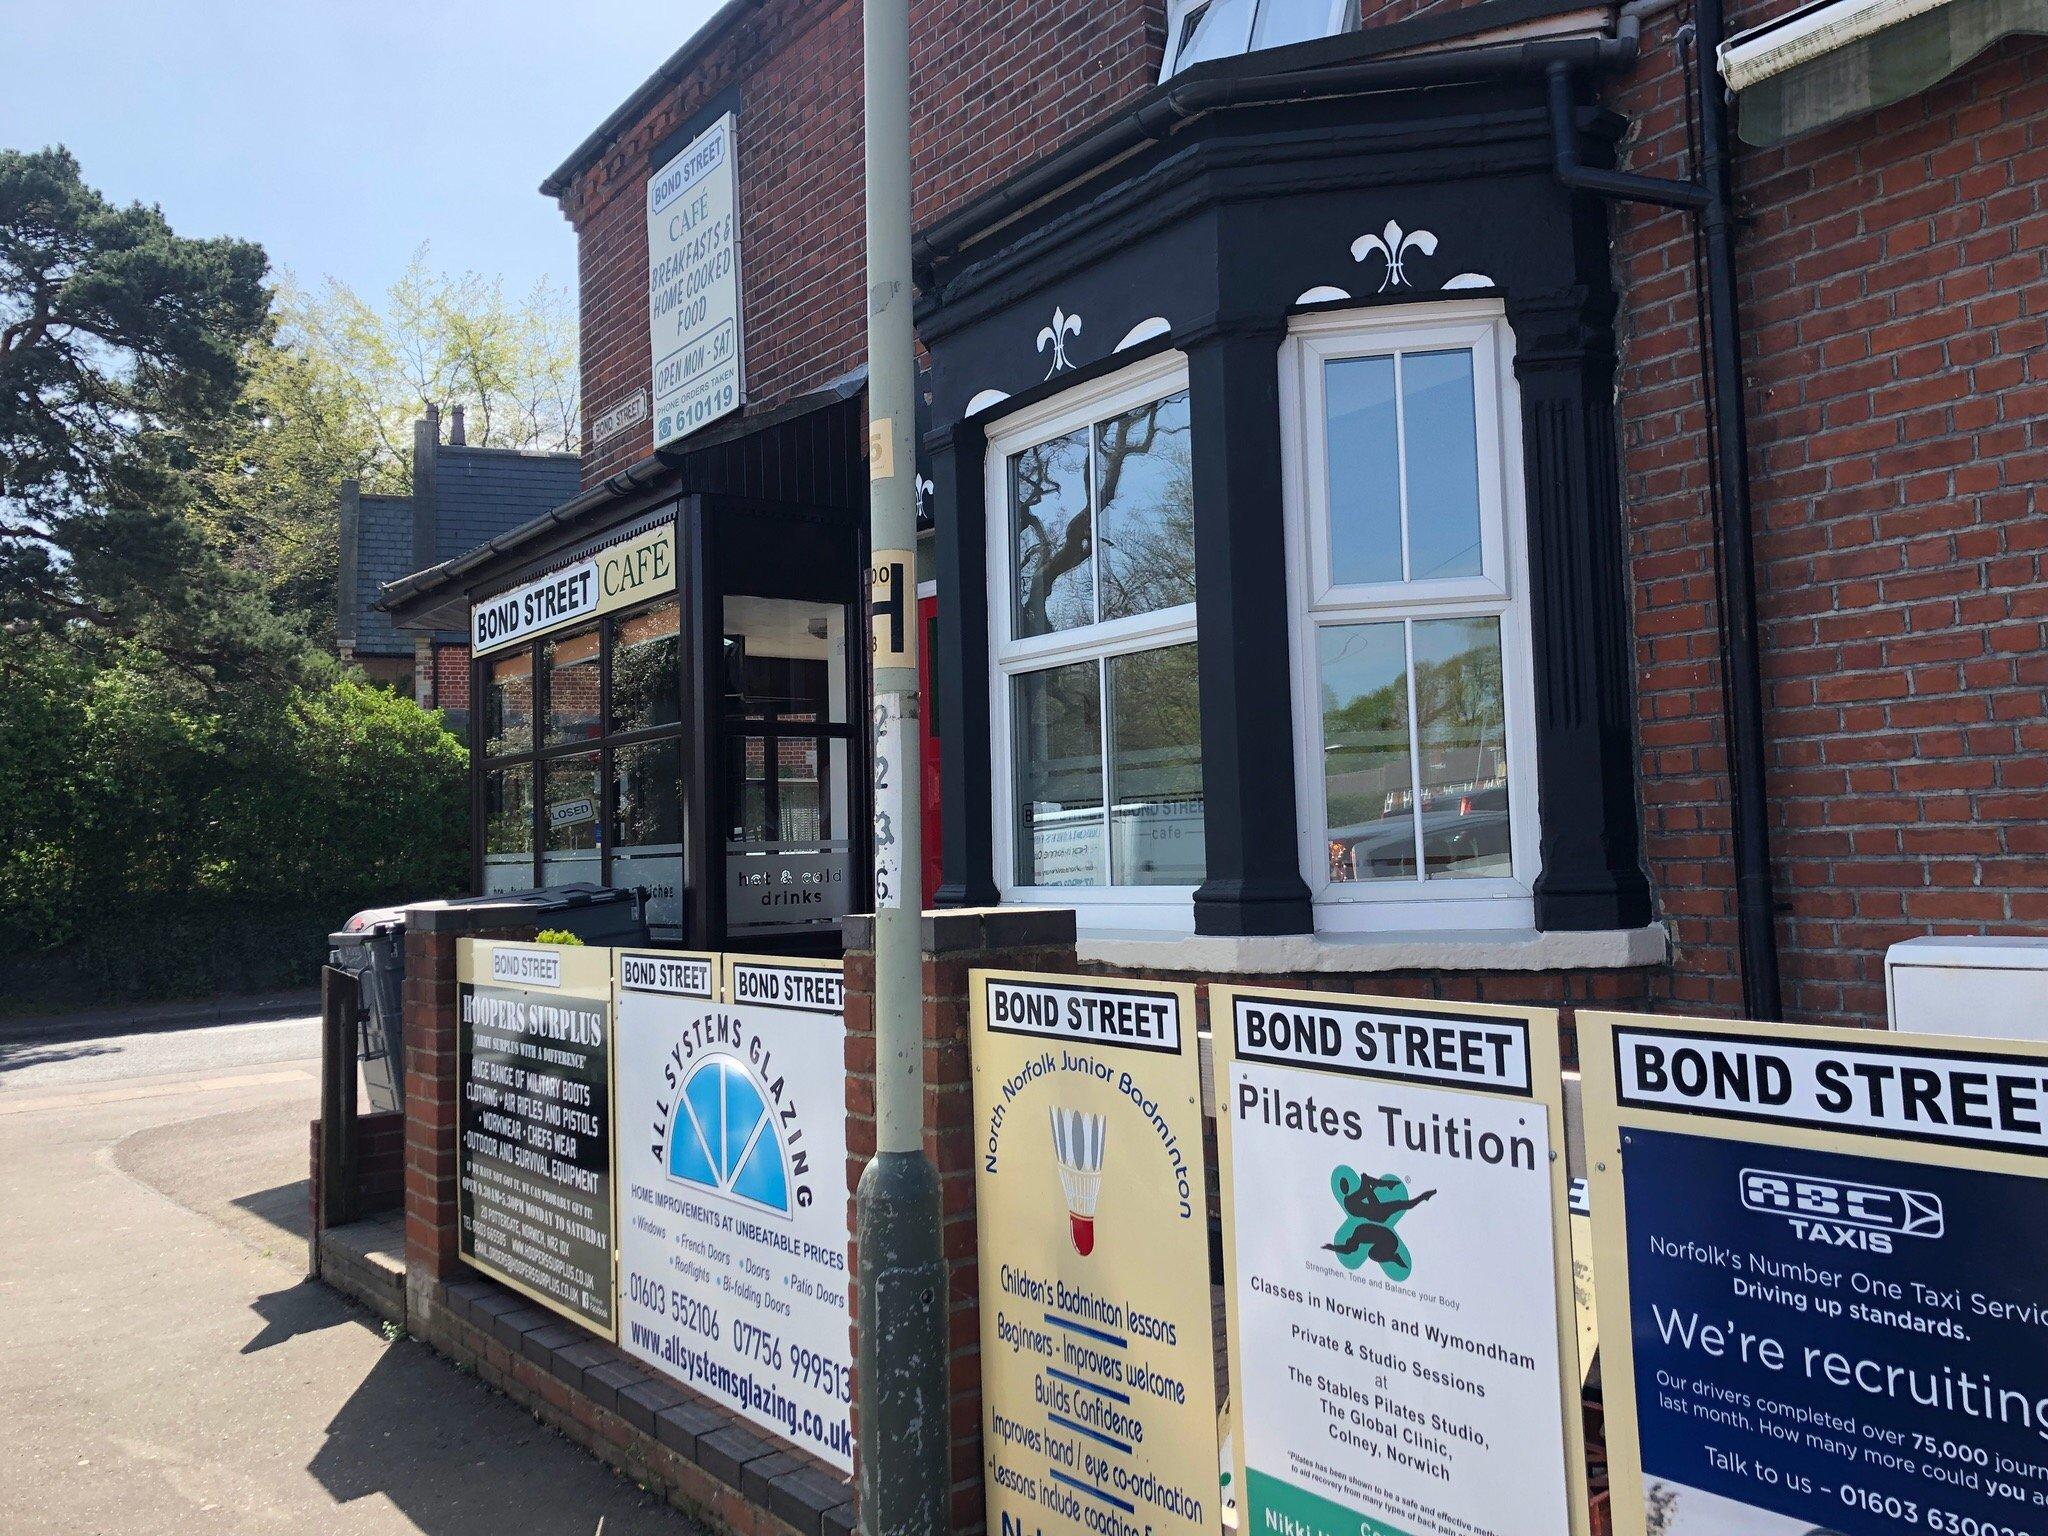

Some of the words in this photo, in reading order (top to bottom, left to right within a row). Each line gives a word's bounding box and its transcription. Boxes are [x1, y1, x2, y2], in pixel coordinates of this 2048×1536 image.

[654, 171, 682, 205] BOND
[683, 136, 722, 183] STREET
[669, 187, 708, 242] CAFÉ
[652, 219, 722, 292] BREAKFASTS
[653, 280, 683, 321] HOME
[686, 247, 731, 299] COOKED
[677, 295, 707, 337] FOOD
[657, 360, 682, 393] OPEN
[684, 348, 704, 378] MON
[713, 328, 732, 364] SAT
[657, 398, 680, 416] PHONE
[681, 381, 709, 404] ORDERS
[710, 367, 735, 388] TAKEN
[616, 399, 641, 427] STREET
[676, 384, 733, 432] 610119
[478, 599, 519, 643] BOND
[524, 569, 591, 627] STREET
[604, 532, 670, 597] CAFÉ
[551, 804, 589, 821] LOSED
[1152, 824, 1181, 840] cafe
[738, 871, 771, 886] hot
[780, 870, 793, 884] &
[801, 868, 842, 884] cold
[761, 890, 822, 906] drinks
[494, 954, 518, 975] BOND
[522, 957, 559, 980] STREET
[624, 962, 656, 986] BOND
[659, 964, 707, 990] STREET
[738, 972, 779, 999] BOND
[784, 976, 844, 1005] STREET
[462, 994, 525, 1033] HOOPERS
[529, 1004, 602, 1048] SURPLUS
[994, 990, 1058, 1028] BOND
[1068, 996, 1168, 1040] STREET
[1245, 1009, 1342, 1057] BOND
[1354, 1020, 1513, 1078] STREET
[466, 1081, 498, 1107] CLOTHING
[517, 1095, 543, 1121] RIFLES
[544, 1101, 561, 1126] AND
[562, 1107, 598, 1138] PISTOLS
[490, 1063, 514, 1087] RANGE
[526, 1072, 561, 1099] MILITARY
[562, 1080, 590, 1107] BOOTS
[651, 1099, 669, 1164] ALL
[664, 1013, 742, 1090] SYSTEMS
[749, 1035, 813, 1208] GLAZING
[1634, 1043, 1792, 1106] BOND
[1815, 1059, 2048, 1135] STREE
[554, 1132, 578, 1160] WEAR
[985, 1102, 1006, 1174] North
[1001, 1052, 1057, 1104] Norfolk
[1060, 1050, 1115, 1083] Junior
[1118, 1071, 1192, 1220] Badminton
[1238, 1082, 1363, 1141] Pilates
[1378, 1104, 1536, 1171] Tuition
[466, 1130, 498, 1158] OUTDOOR
[514, 1146, 550, 1177] SURVIVAL
[551, 1158, 599, 1196] EQUIPMENT
[631, 1184, 654, 1205] HOME
[655, 1189, 720, 1227] IMPROVEMENTS
[721, 1213, 732, 1231] AT
[735, 1220, 801, 1256] UNBEATABLE
[804, 1243, 844, 1271] PRICES
[1747, 1175, 1894, 1224] ABC
[636, 1216, 666, 1239] Windows
[681, 1234, 706, 1256] French
[708, 1244, 730, 1266] Doors
[745, 1258, 770, 1280] Doors
[790, 1274, 813, 1297] Patio
[816, 1281, 844, 1308] Doors
[1788, 1218, 1894, 1255] TAXIS
[674, 1257, 710, 1284] Rooflights
[723, 1275, 760, 1308] Bi-folding
[764, 1290, 791, 1317] Doors
[1000, 1263, 1054, 1307] Children's
[1057, 1279, 1123, 1330] Badminton
[1126, 1301, 1177, 1346] lessons
[1349, 1272, 1366, 1285] Tone
[1368, 1278, 1383, 1290] and
[1385, 1282, 1416, 1298] Balance
[1418, 1291, 1437, 1304] your
[1439, 1296, 1460, 1311] Body
[1649, 1234, 1743, 1271] Norfolk's
[1749, 1253, 1843, 1290] Number
[1850, 1272, 1903, 1300] One
[1910, 1282, 1961, 1311] Taxi
[630, 1272, 665, 1315] 01603
[672, 1290, 719, 1342] 552106
[733, 1319, 782, 1371] 07756
[790, 1344, 850, 1404] 999513
[1250, 1276, 1304, 1304] Classes
[1308, 1290, 1322, 1308] in
[1326, 1296, 1386, 1329] Norwich
[1391, 1316, 1420, 1338] and
[1424, 1324, 1536, 1372] Wymondham
[1733, 1278, 1808, 1312] Driving
[1814, 1296, 1842, 1318] up
[1849, 1302, 1972, 1342] standards.
[631, 1320, 852, 1458] www.allsystemsglazing.co.uk
[997, 1311, 1053, 1357] Beginners
[1063, 1334, 1122, 1382] Improvers
[1126, 1361, 1186, 1405] welcome
[1292, 1324, 1340, 1353] Private
[1344, 1340, 1354, 1357] &
[1359, 1344, 1408, 1374] Studio
[1412, 1362, 1486, 1398] Sessions
[1374, 1374, 1388, 1390] at
[1652, 1304, 1786, 1371] We're
[1804, 1343, 2048, 1441] recruiting
[1035, 1374, 1070, 1415] Builds
[1073, 1388, 1144, 1444] Confidence
[1288, 1365, 1314, 1388] The
[1317, 1375, 1369, 1407] Stables
[1374, 1394, 1426, 1426] Pilates
[1431, 1414, 1490, 1451] Studio,
[1320, 1398, 1346, 1420] The
[1350, 1409, 1398, 1440] Global
[1403, 1427, 1454, 1462] Clinic,
[1656, 1369, 1686, 1392] Our
[1692, 1377, 1750, 1408] drivers
[1756, 1394, 1856, 1435] completed
[1862, 1424, 1906, 1446] over
[1912, 1432, 1989, 1467] 75,000
[1995, 1452, 2048, 1482] journ
[992, 1405, 1042, 1454] Improves
[1044, 1425, 1074, 1468] hand
[1084, 1452, 1110, 1488] eye
[1112, 1464, 1204, 1525] co-ordination
[1328, 1424, 1382, 1460] Colney,
[1386, 1444, 1450, 1482] Norwich
[1658, 1392, 1688, 1413] last
[1693, 1400, 1754, 1432] month.
[1760, 1419, 1800, 1444] How
[1806, 1435, 1857, 1462] many
[1864, 1450, 1916, 1475] more
[1922, 1464, 1979, 1490] could
[1985, 1478, 2026, 1502] you
[1039, 1479, 1081, 1523] include
[1084, 1503, 1144, 1536] coaching
[1704, 1445, 1748, 1477] Talk
[1754, 1461, 1780, 1485] to
[1786, 1474, 1812, 1496] us
[1840, 1484, 1918, 1524] 01603
